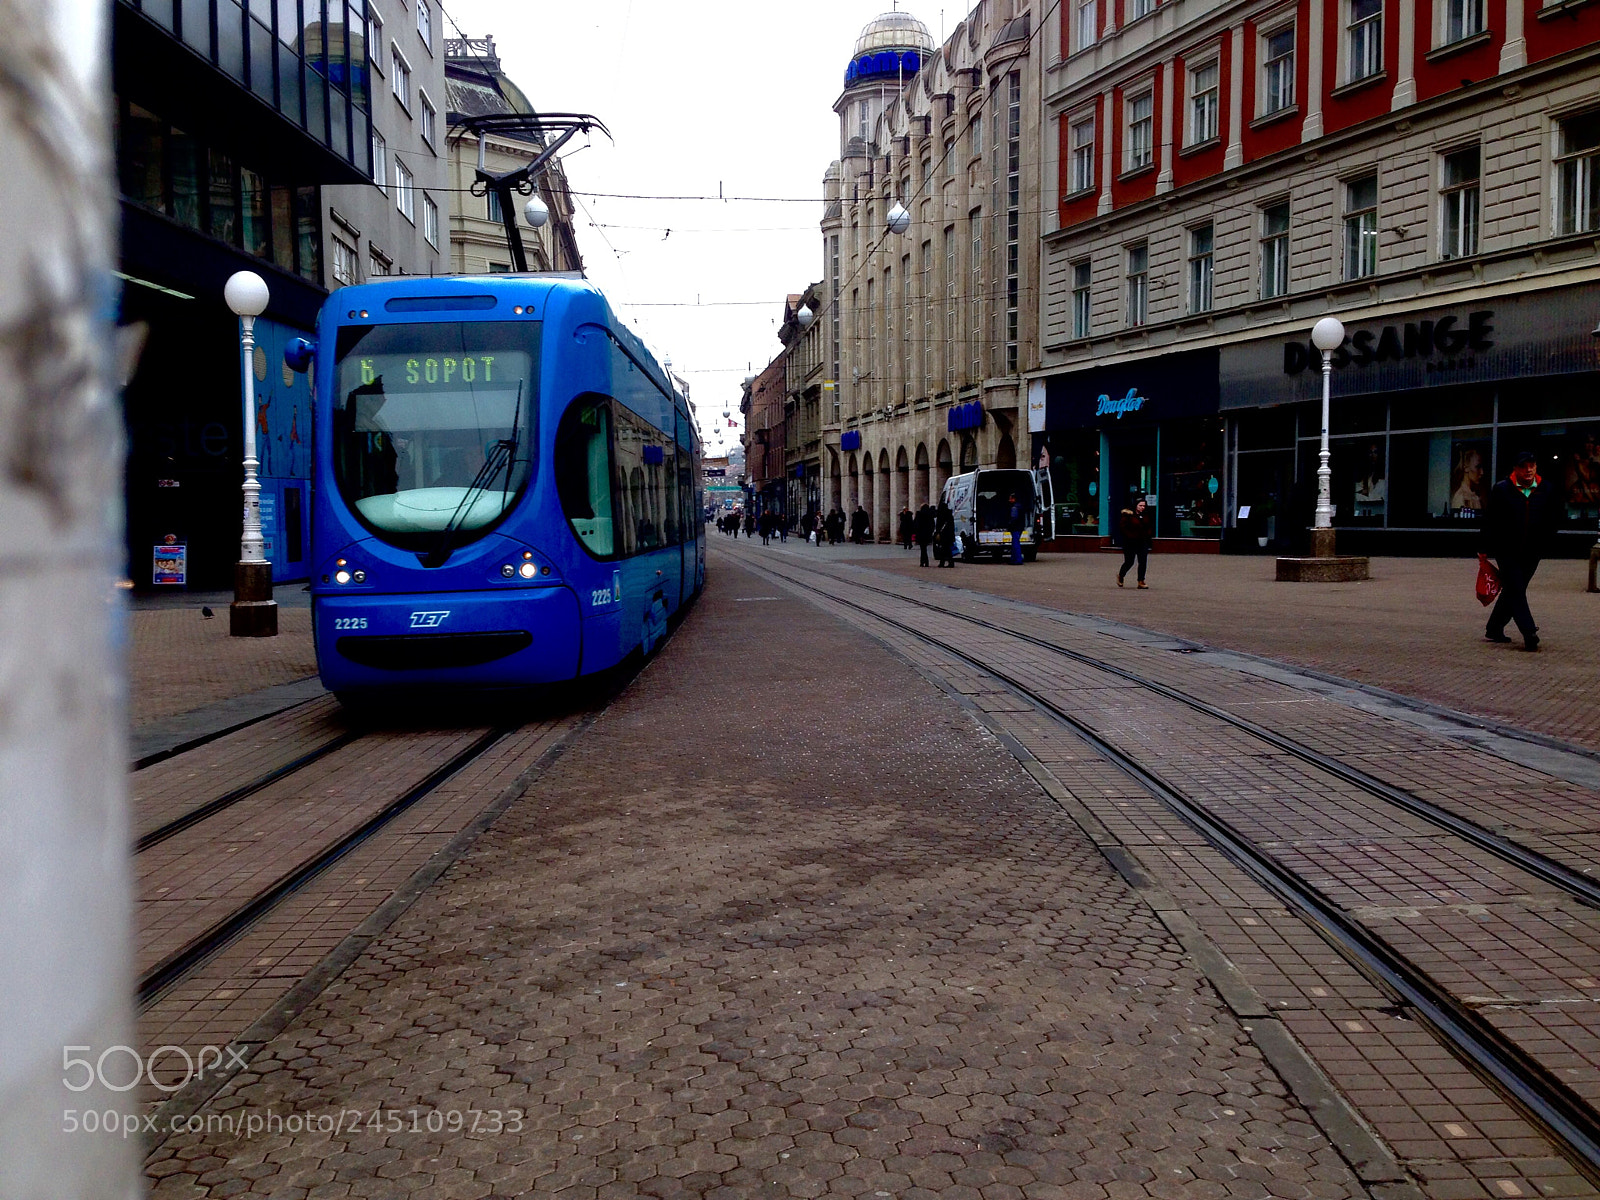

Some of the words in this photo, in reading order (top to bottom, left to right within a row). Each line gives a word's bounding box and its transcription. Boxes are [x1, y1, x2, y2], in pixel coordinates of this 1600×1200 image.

[406, 357, 494, 383] SOPOT
[592, 588, 611, 606] 2225
[335, 618, 367, 629] 2225
[410, 611, 450, 627] ZET
